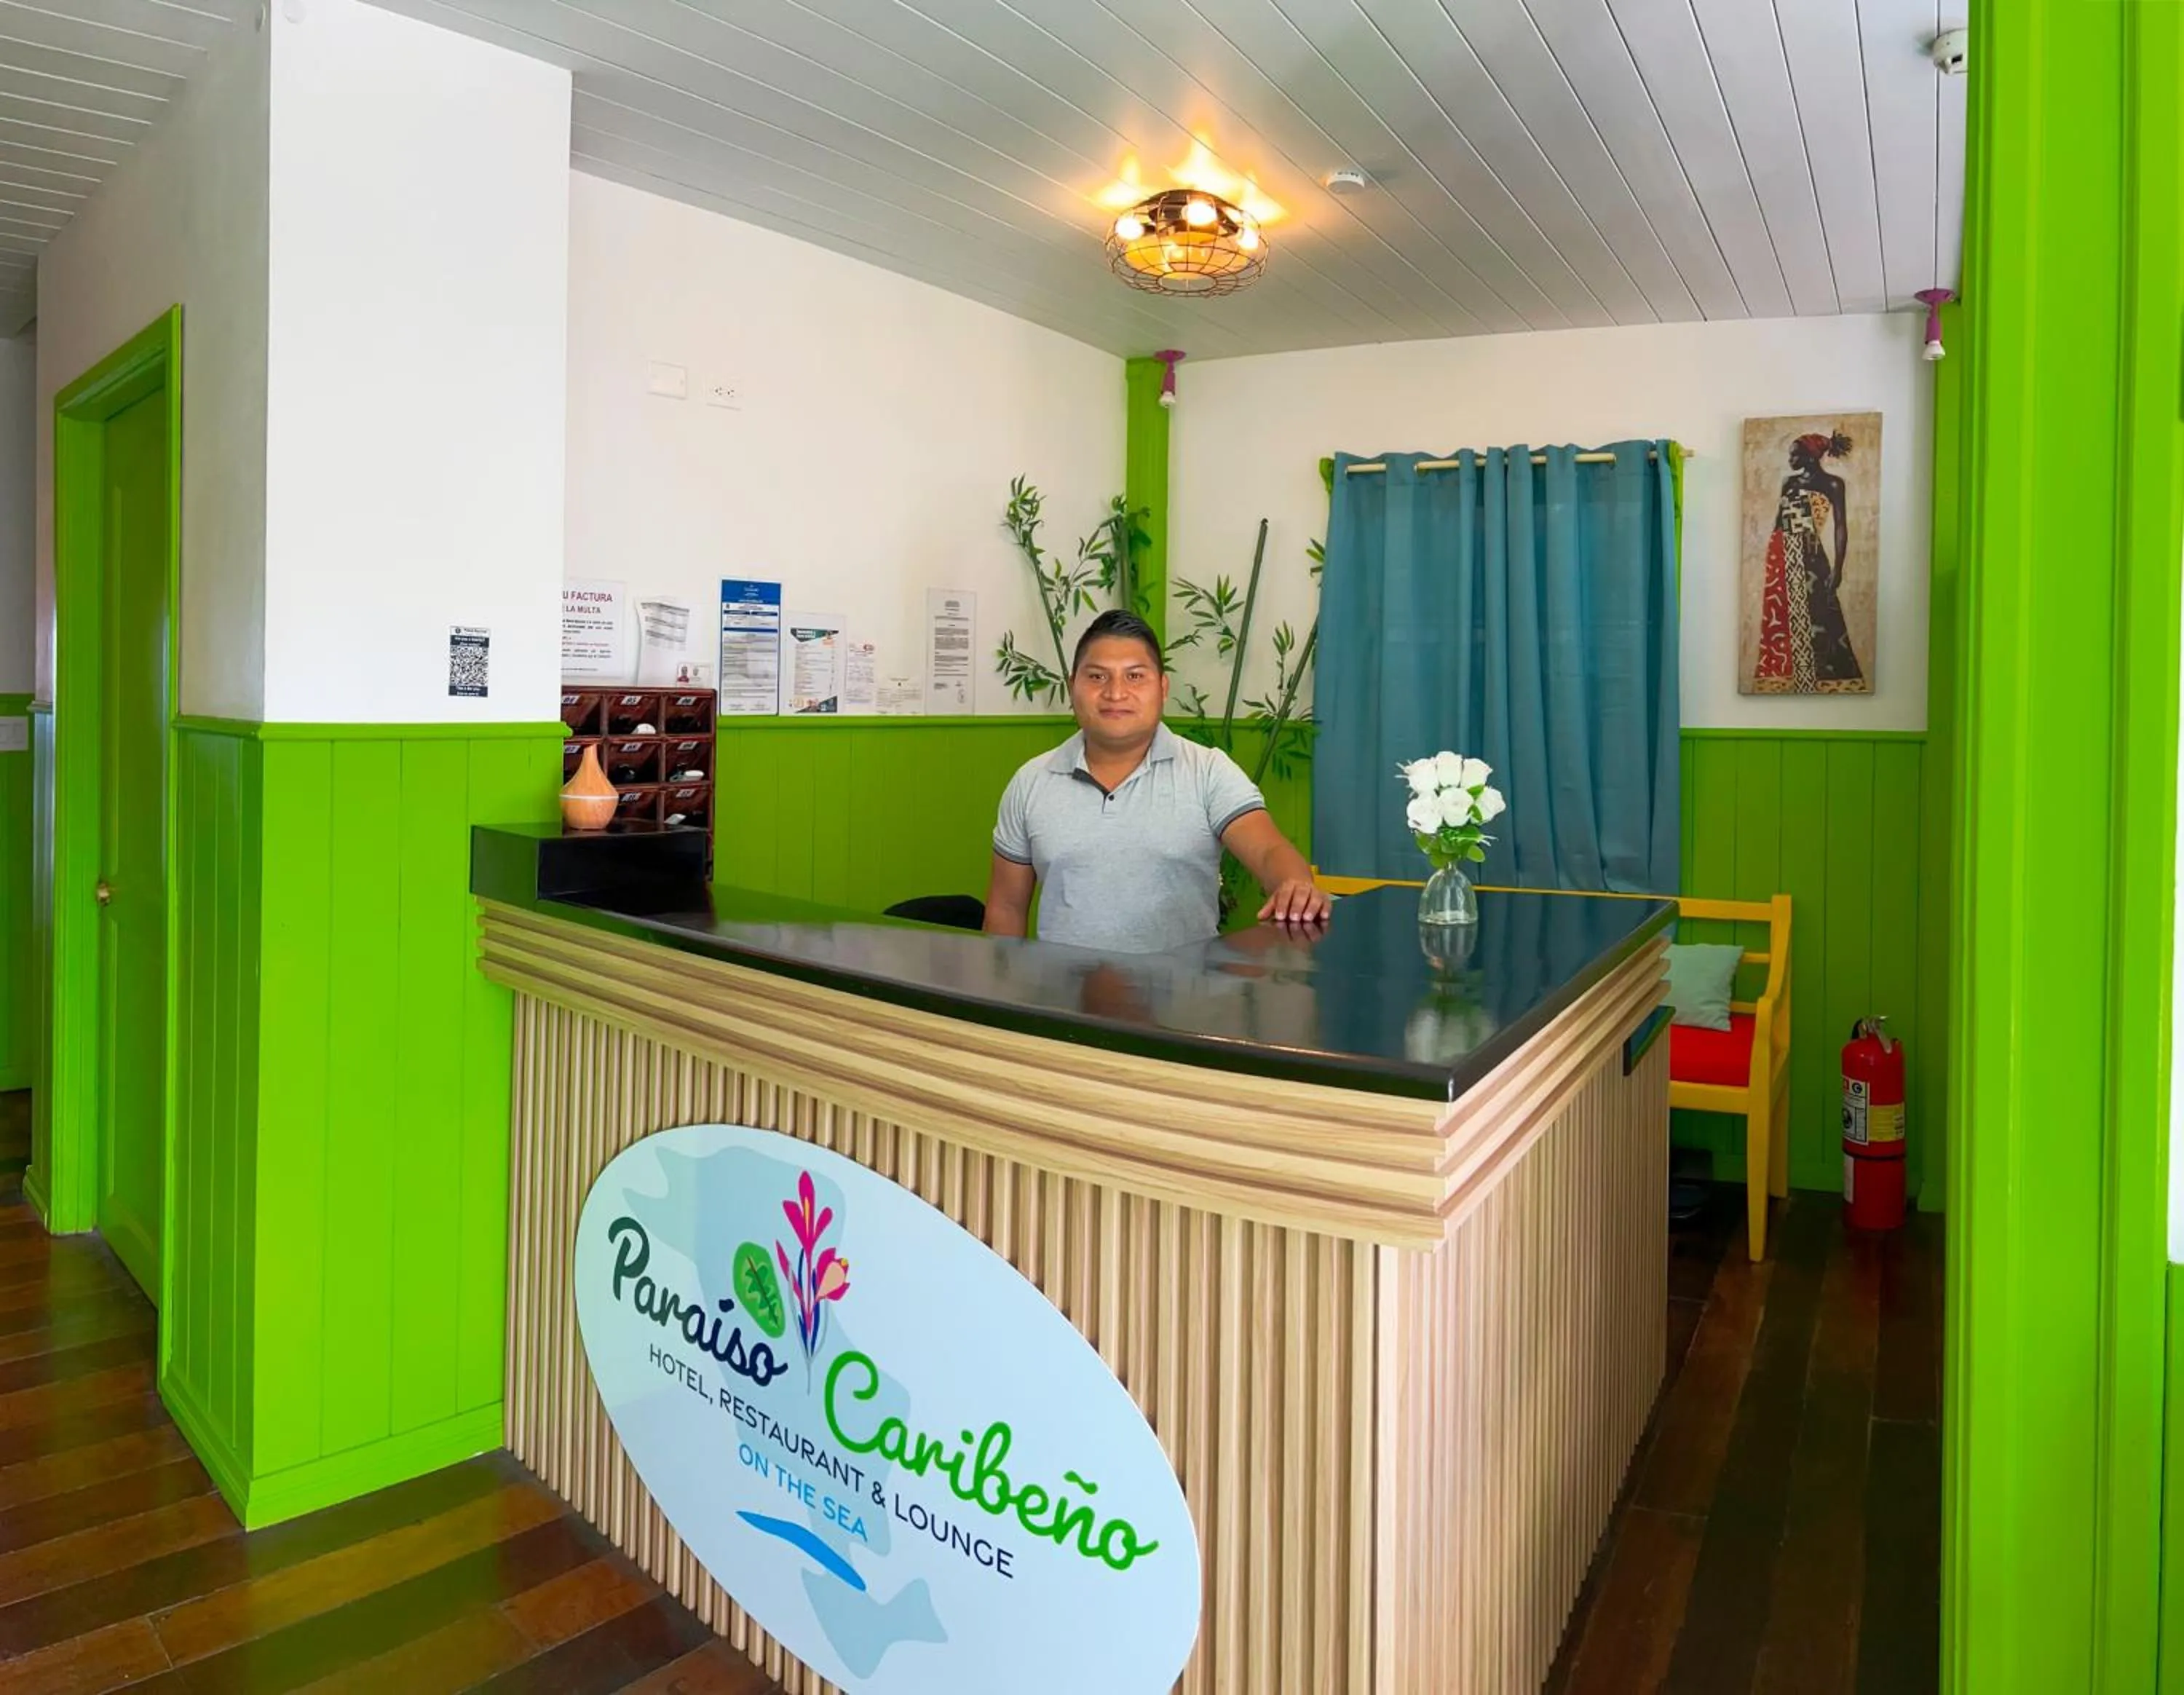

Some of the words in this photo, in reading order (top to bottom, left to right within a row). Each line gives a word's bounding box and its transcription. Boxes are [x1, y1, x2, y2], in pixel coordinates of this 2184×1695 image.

[570, 590, 613, 603] FACTURA
[577, 605, 601, 614] MULTA
[650, 1343, 714, 1404] HOTEL,
[719, 1388, 865, 1493] RESTAURANT
[871, 1481, 886, 1509] &
[895, 1493, 1014, 1579] LOUNGE
[739, 1443, 769, 1477] ON
[775, 1464, 816, 1509] THE
[822, 1496, 869, 1543] SEA
[824, 1351, 1159, 1570] Caribeño
